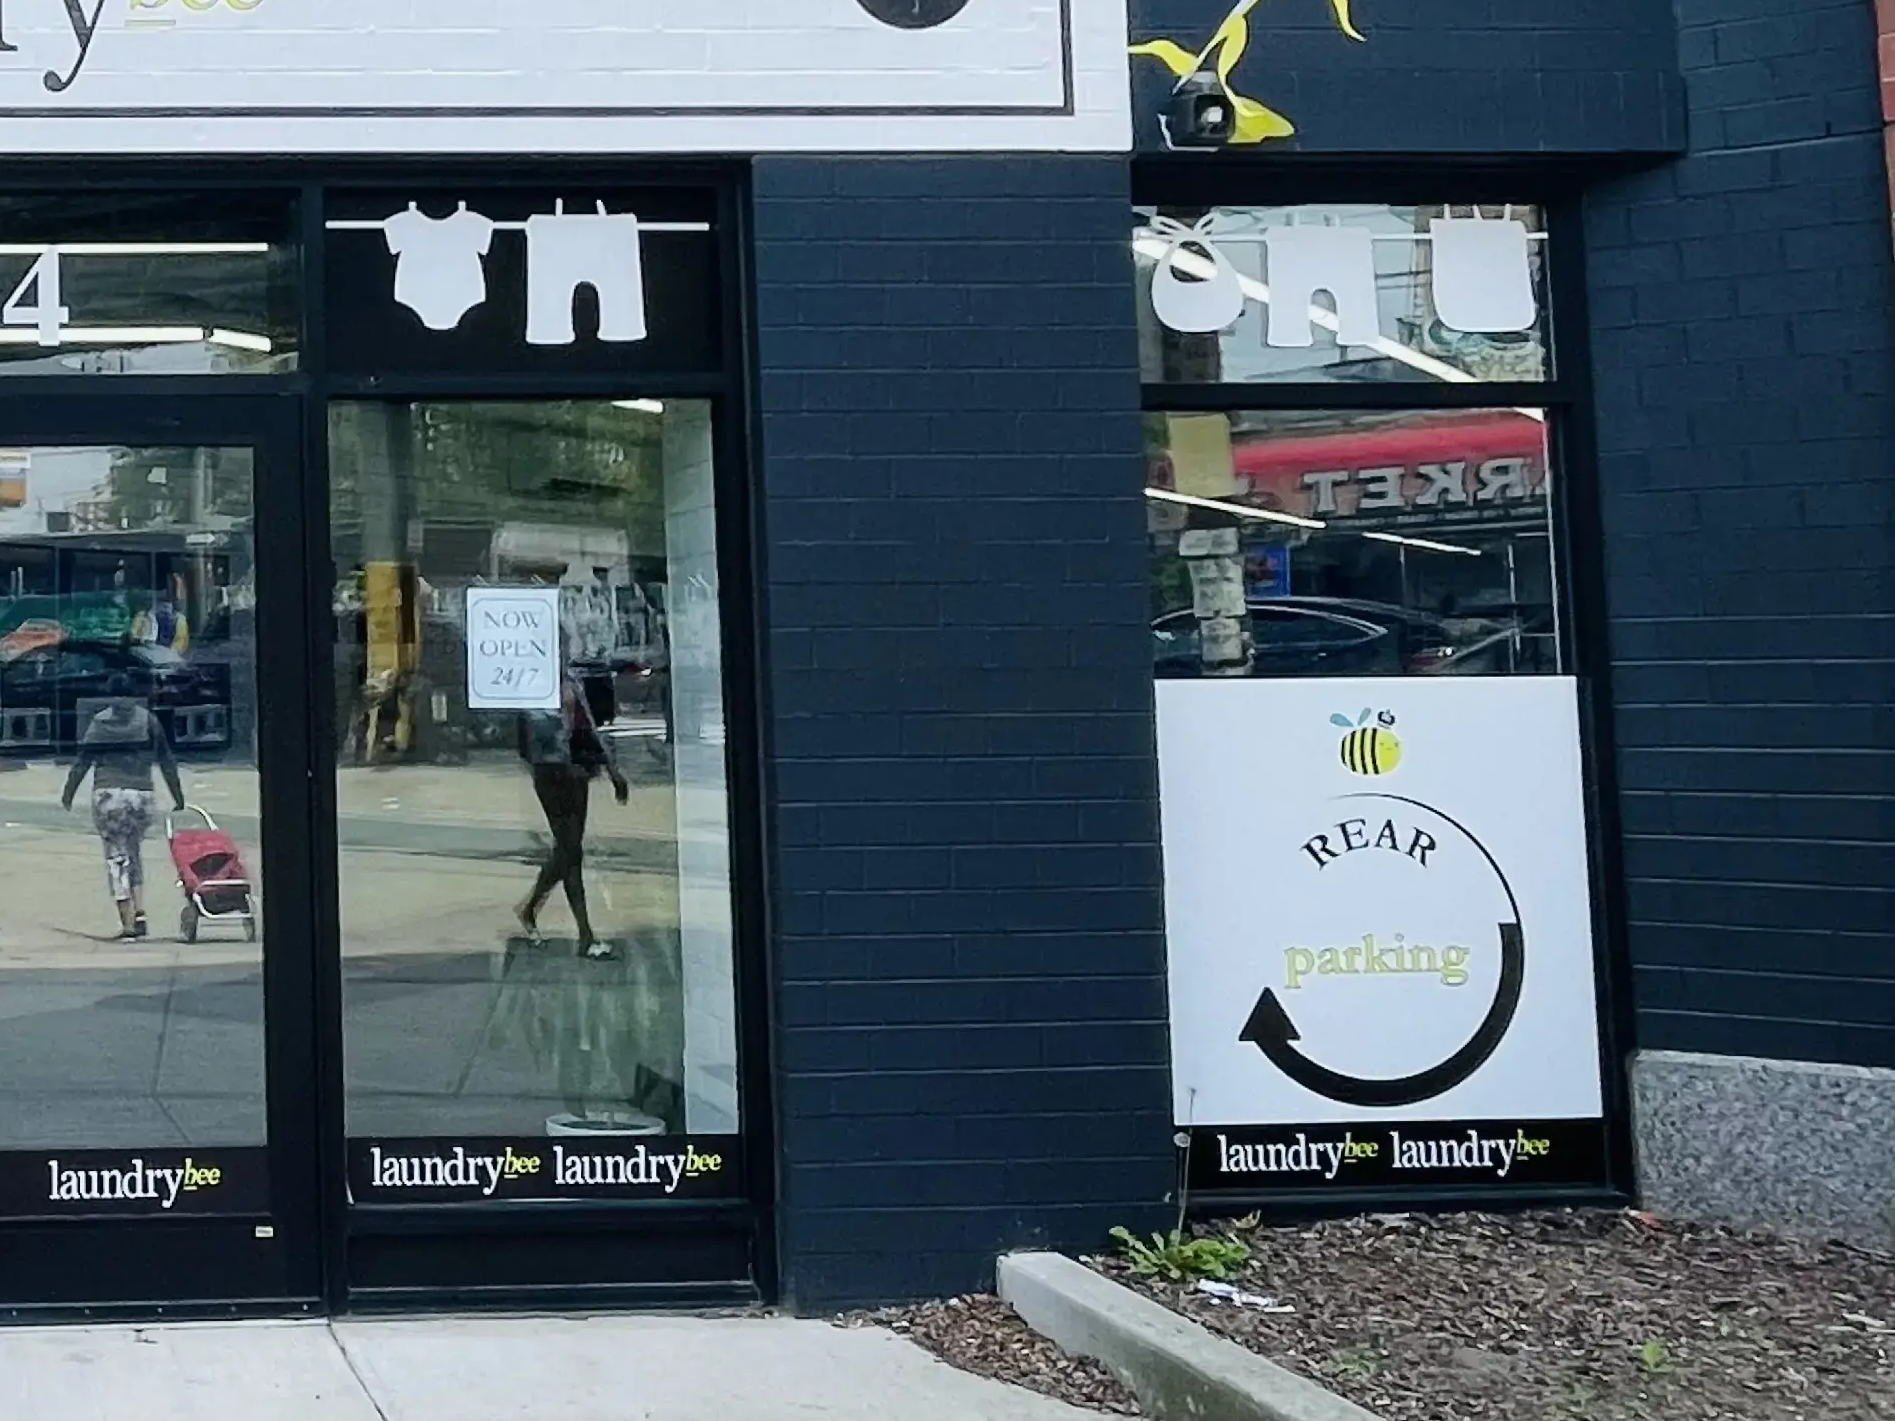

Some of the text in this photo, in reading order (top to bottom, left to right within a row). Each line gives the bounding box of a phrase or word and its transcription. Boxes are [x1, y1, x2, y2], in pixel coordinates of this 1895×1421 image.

[484, 610, 543, 629] NOW
[479, 639, 547, 658] OPEN
[490, 666, 540, 688] 24/7
[1301, 818, 1437, 870] REAR
[1283, 932, 1471, 989] parking
